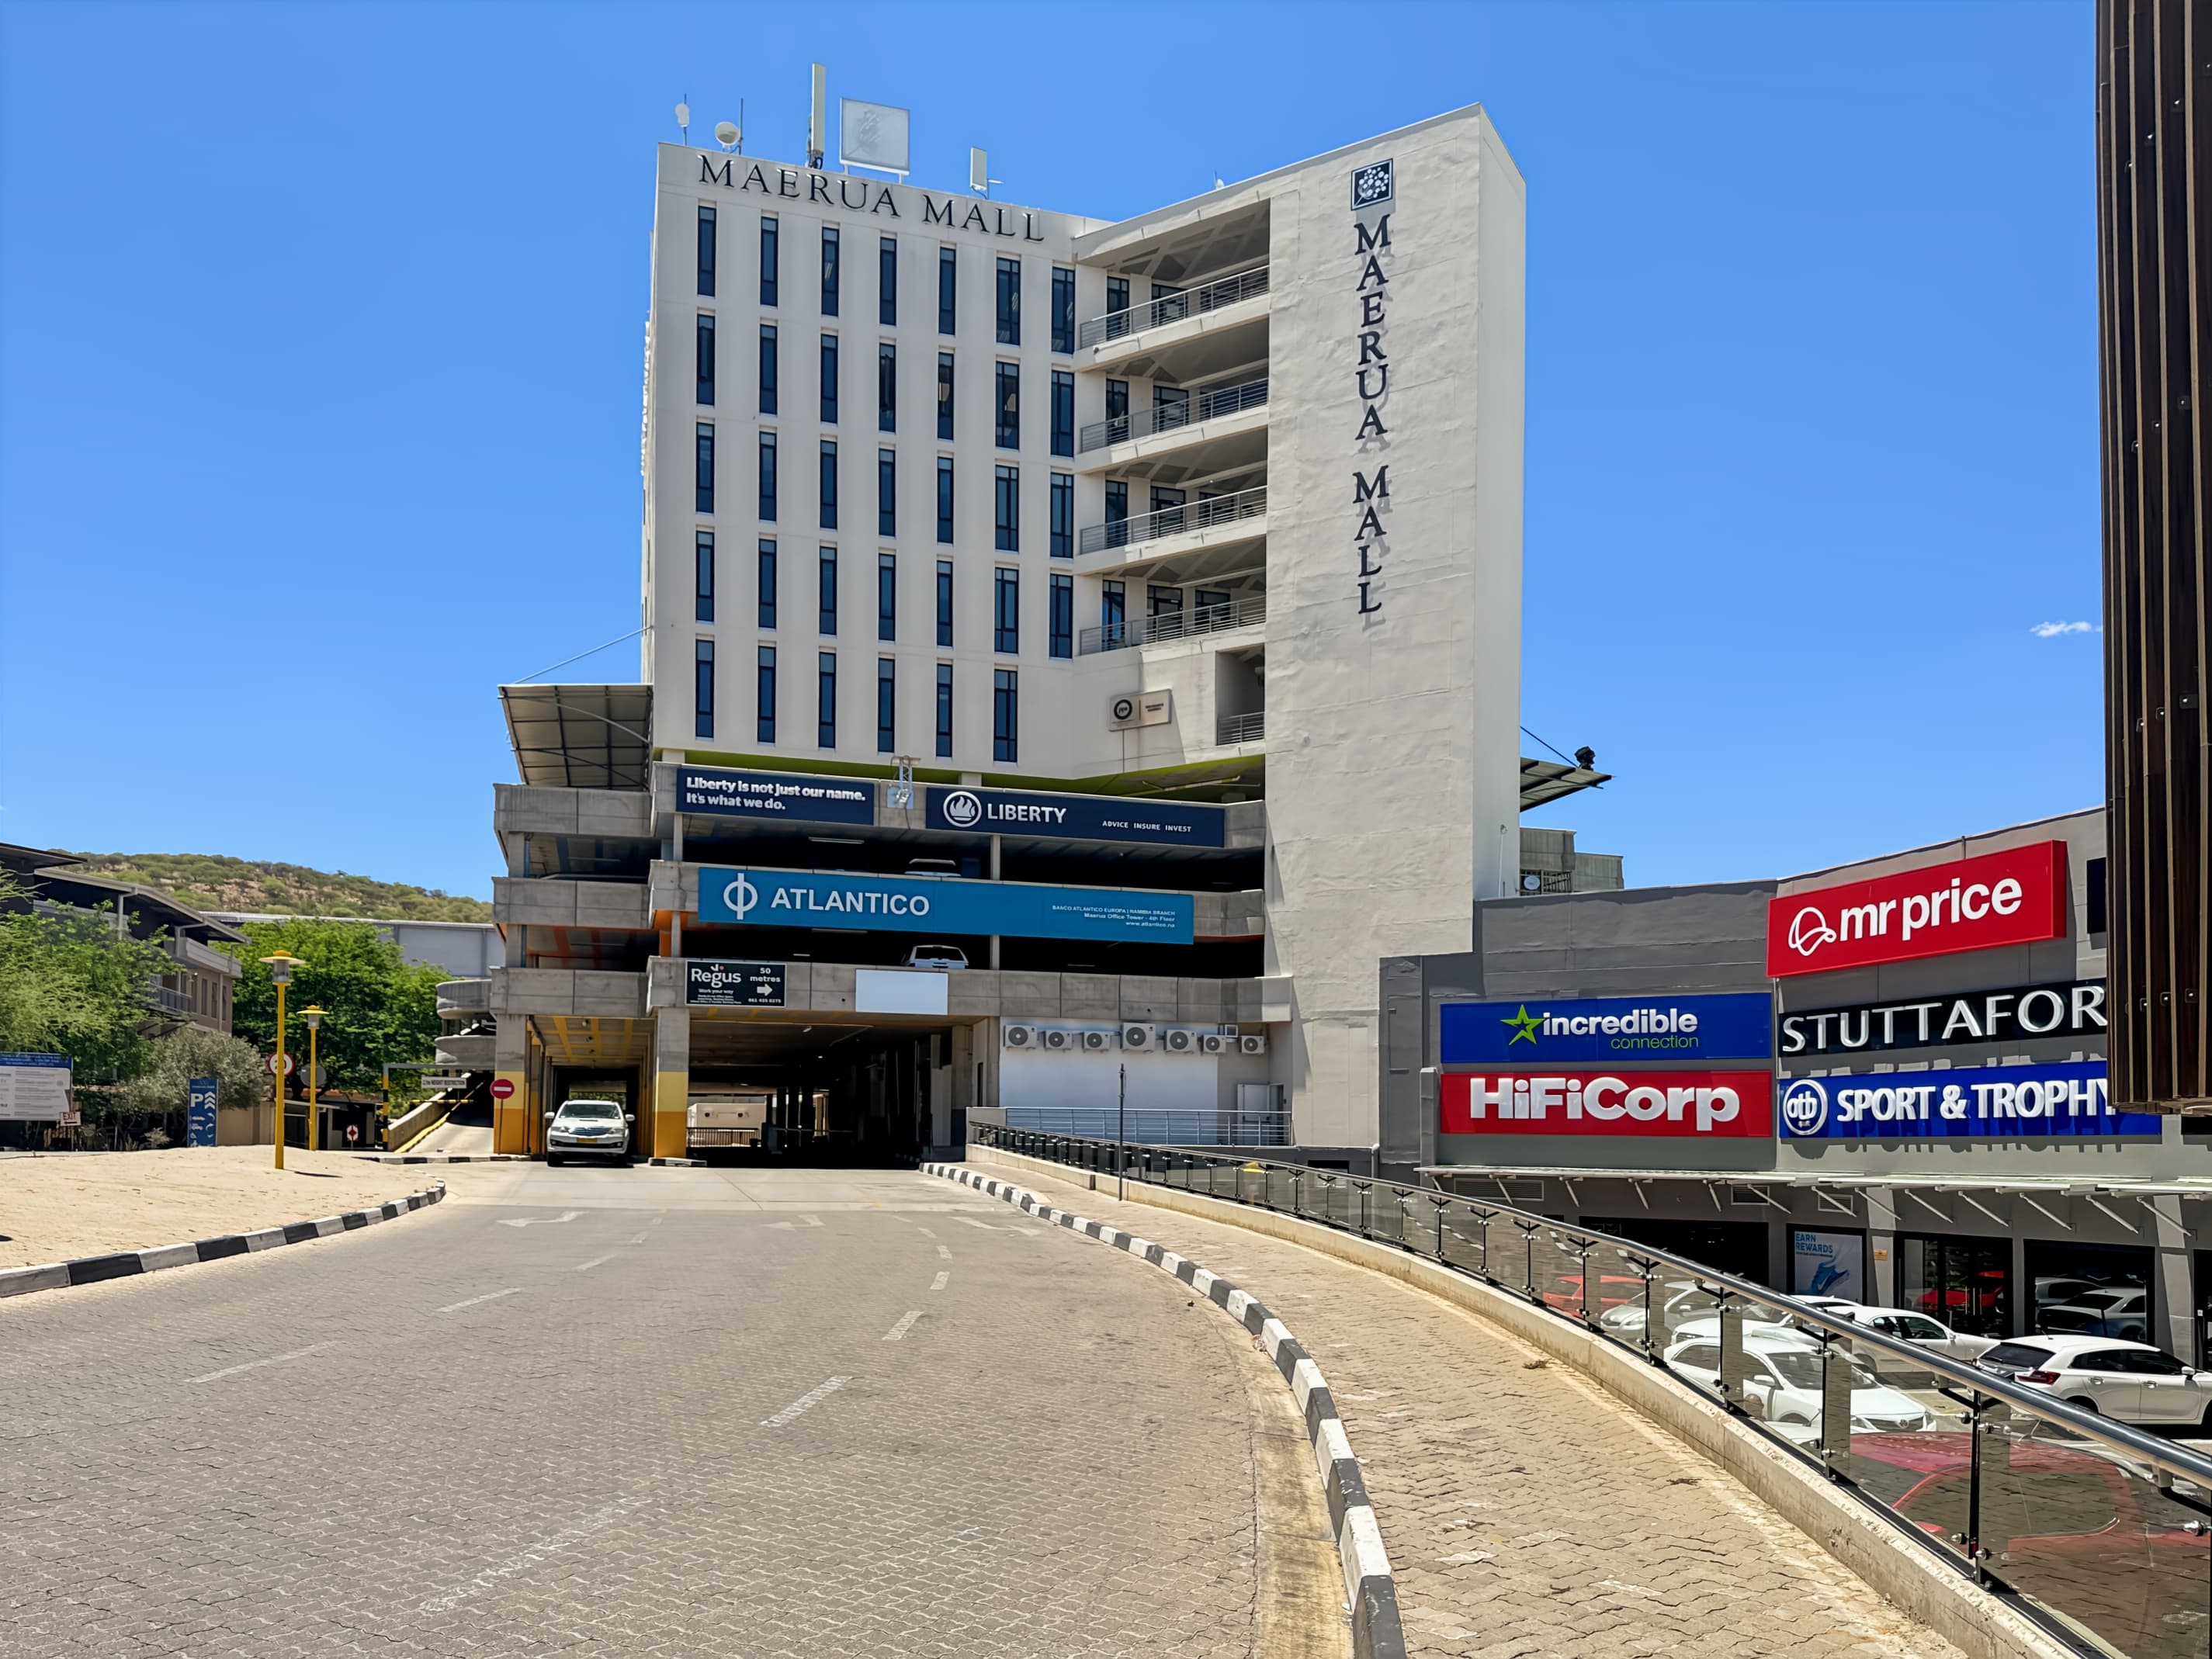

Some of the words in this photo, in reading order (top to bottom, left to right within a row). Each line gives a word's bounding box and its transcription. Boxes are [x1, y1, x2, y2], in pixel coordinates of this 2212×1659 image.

[699, 154, 900, 218] MAERUA
[922, 193, 1043, 242] MALL
[1354, 213, 1391, 440] MAERUA
[1353, 466, 1389, 614] MALL
[686, 777, 737, 793] Liberty
[738, 780, 749, 792] is
[750, 784, 774, 794] not
[775, 784, 800, 796] just
[802, 788, 824, 798] our
[825, 789, 865, 801] name.
[686, 792, 706, 803] It's
[707, 794, 741, 806] what
[743, 798, 763, 808] we
[764, 798, 785, 810] do.
[987, 803, 1066, 823] LIBERTY
[1102, 820, 1129, 829] ADVICE
[771, 888, 929, 916] ATLANTICO
[1839, 899, 1896, 941] mr
[1902, 878, 2022, 941] price
[691, 968, 741, 988] Regus
[1543, 1008, 1697, 1035] incredible
[1610, 1035, 1698, 1049] connection
[190, 1093, 203, 1107] P
[1469, 1076, 1739, 1131] HiFiCorp
[1837, 1086, 1936, 1122] SPORT
[1940, 1085, 1967, 1120] &
[1795, 1233, 1816, 1242] EARN
[1795, 1242, 1833, 1254] REWARDS
